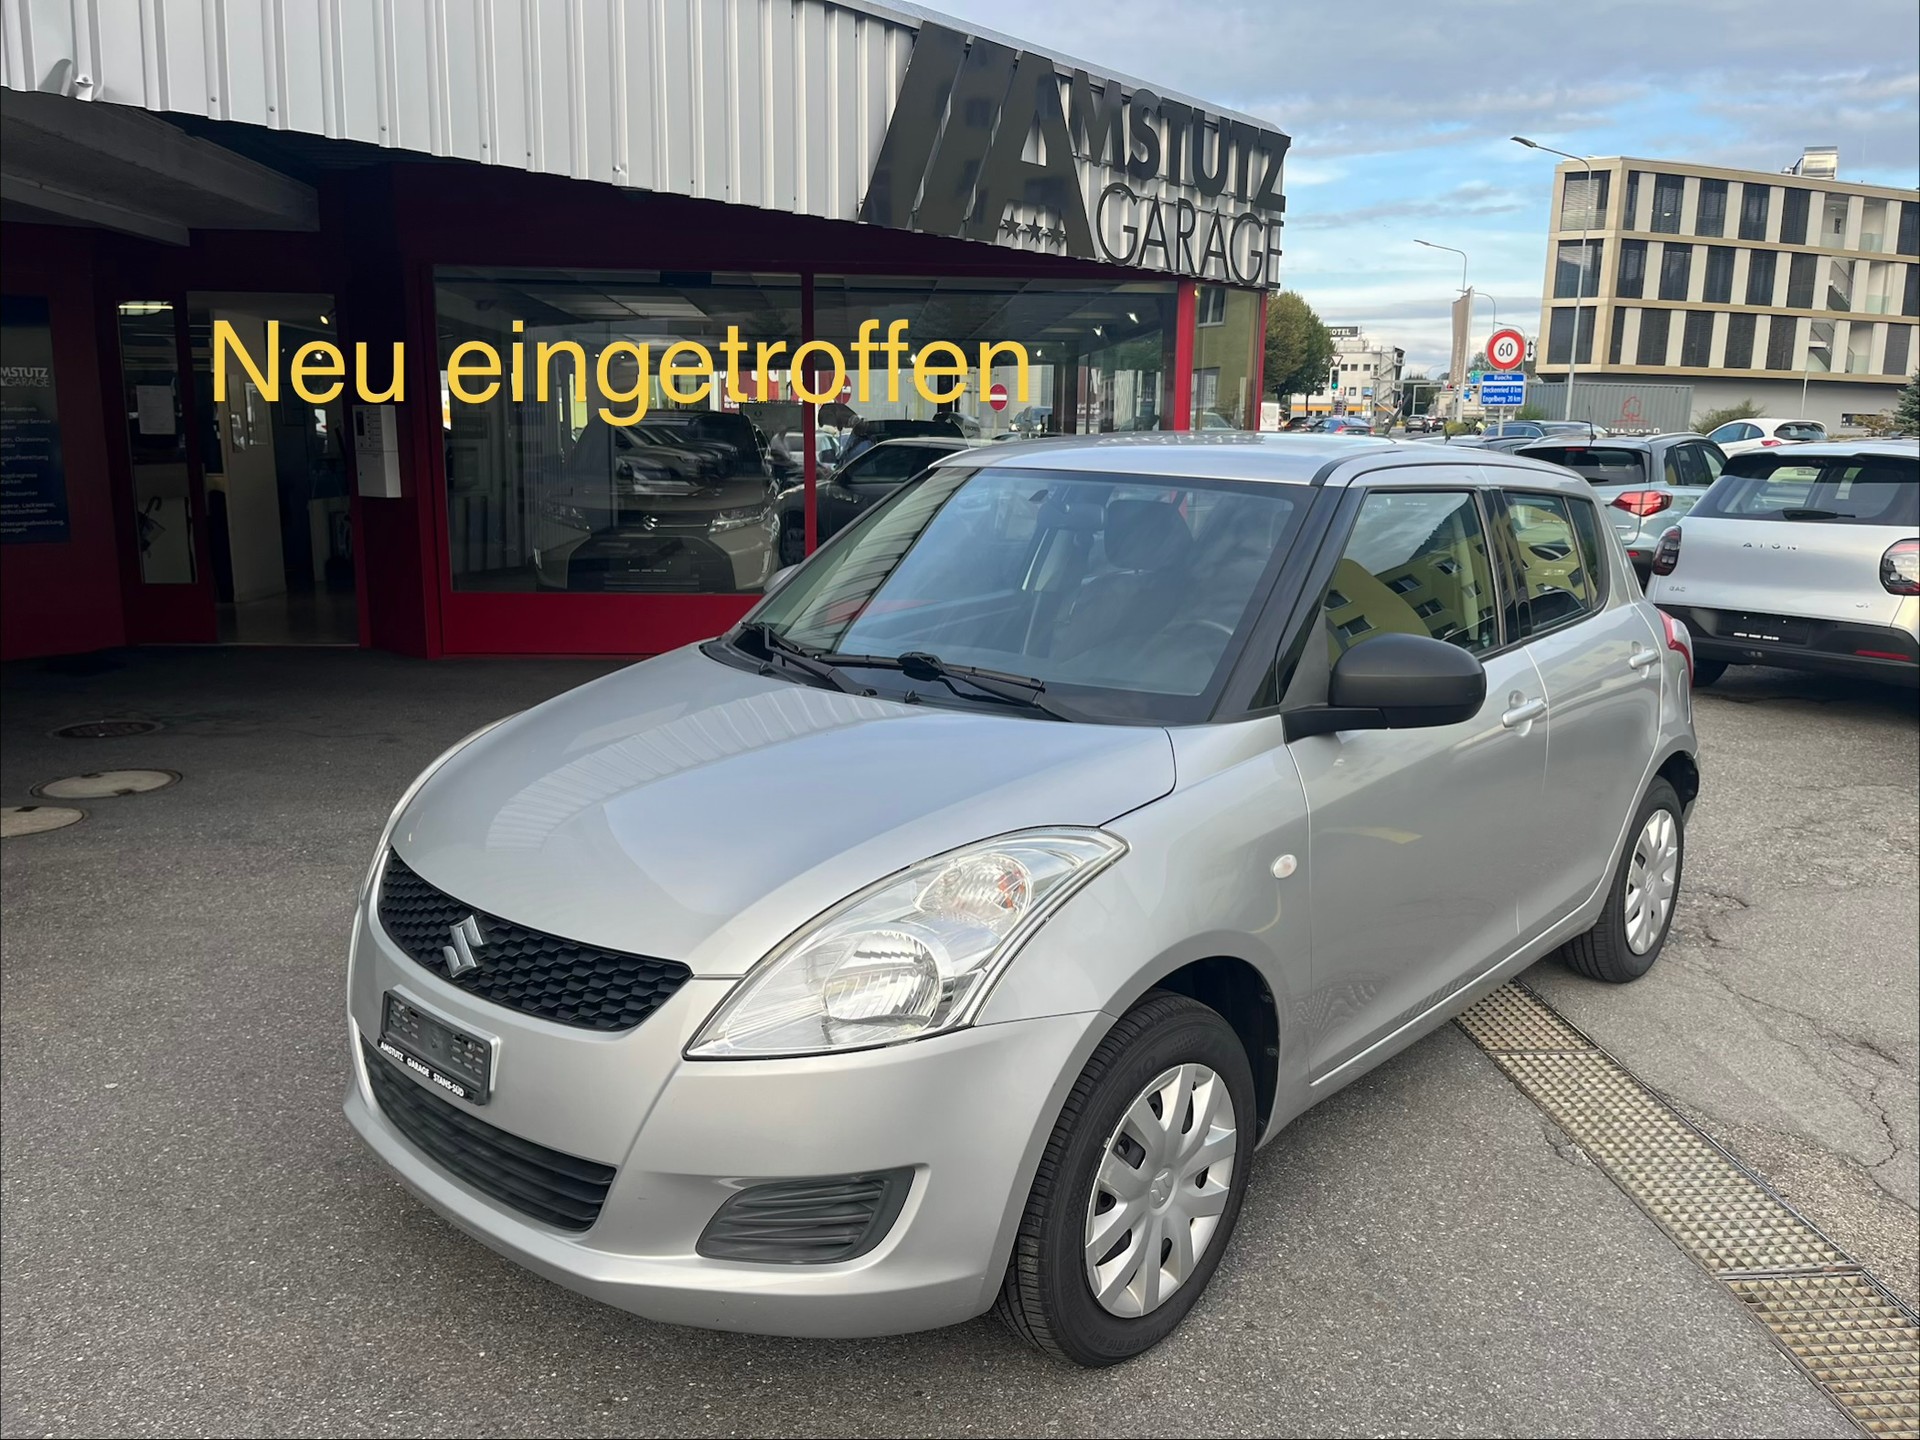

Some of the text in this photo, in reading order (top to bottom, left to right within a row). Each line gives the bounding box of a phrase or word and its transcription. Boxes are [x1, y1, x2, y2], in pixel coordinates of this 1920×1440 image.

[858, 20, 1292, 259] AMSTUTZ
[1096, 182, 1285, 289] GARAGE
[1329, 328, 1351, 336] OTEL
[1498, 343, 1513, 357] 60
[0, 366, 49, 378] MSTUTZ
[5, 377, 51, 388] GARAGE
[1483, 386, 1510, 394] Beckenried
[1514, 386, 1522, 394] km
[1482, 395, 1521, 404] Engelberg 20 km
[380, 1041, 404, 1062] AMSTUTZ
[407, 1057, 430, 1078] GARAGE
